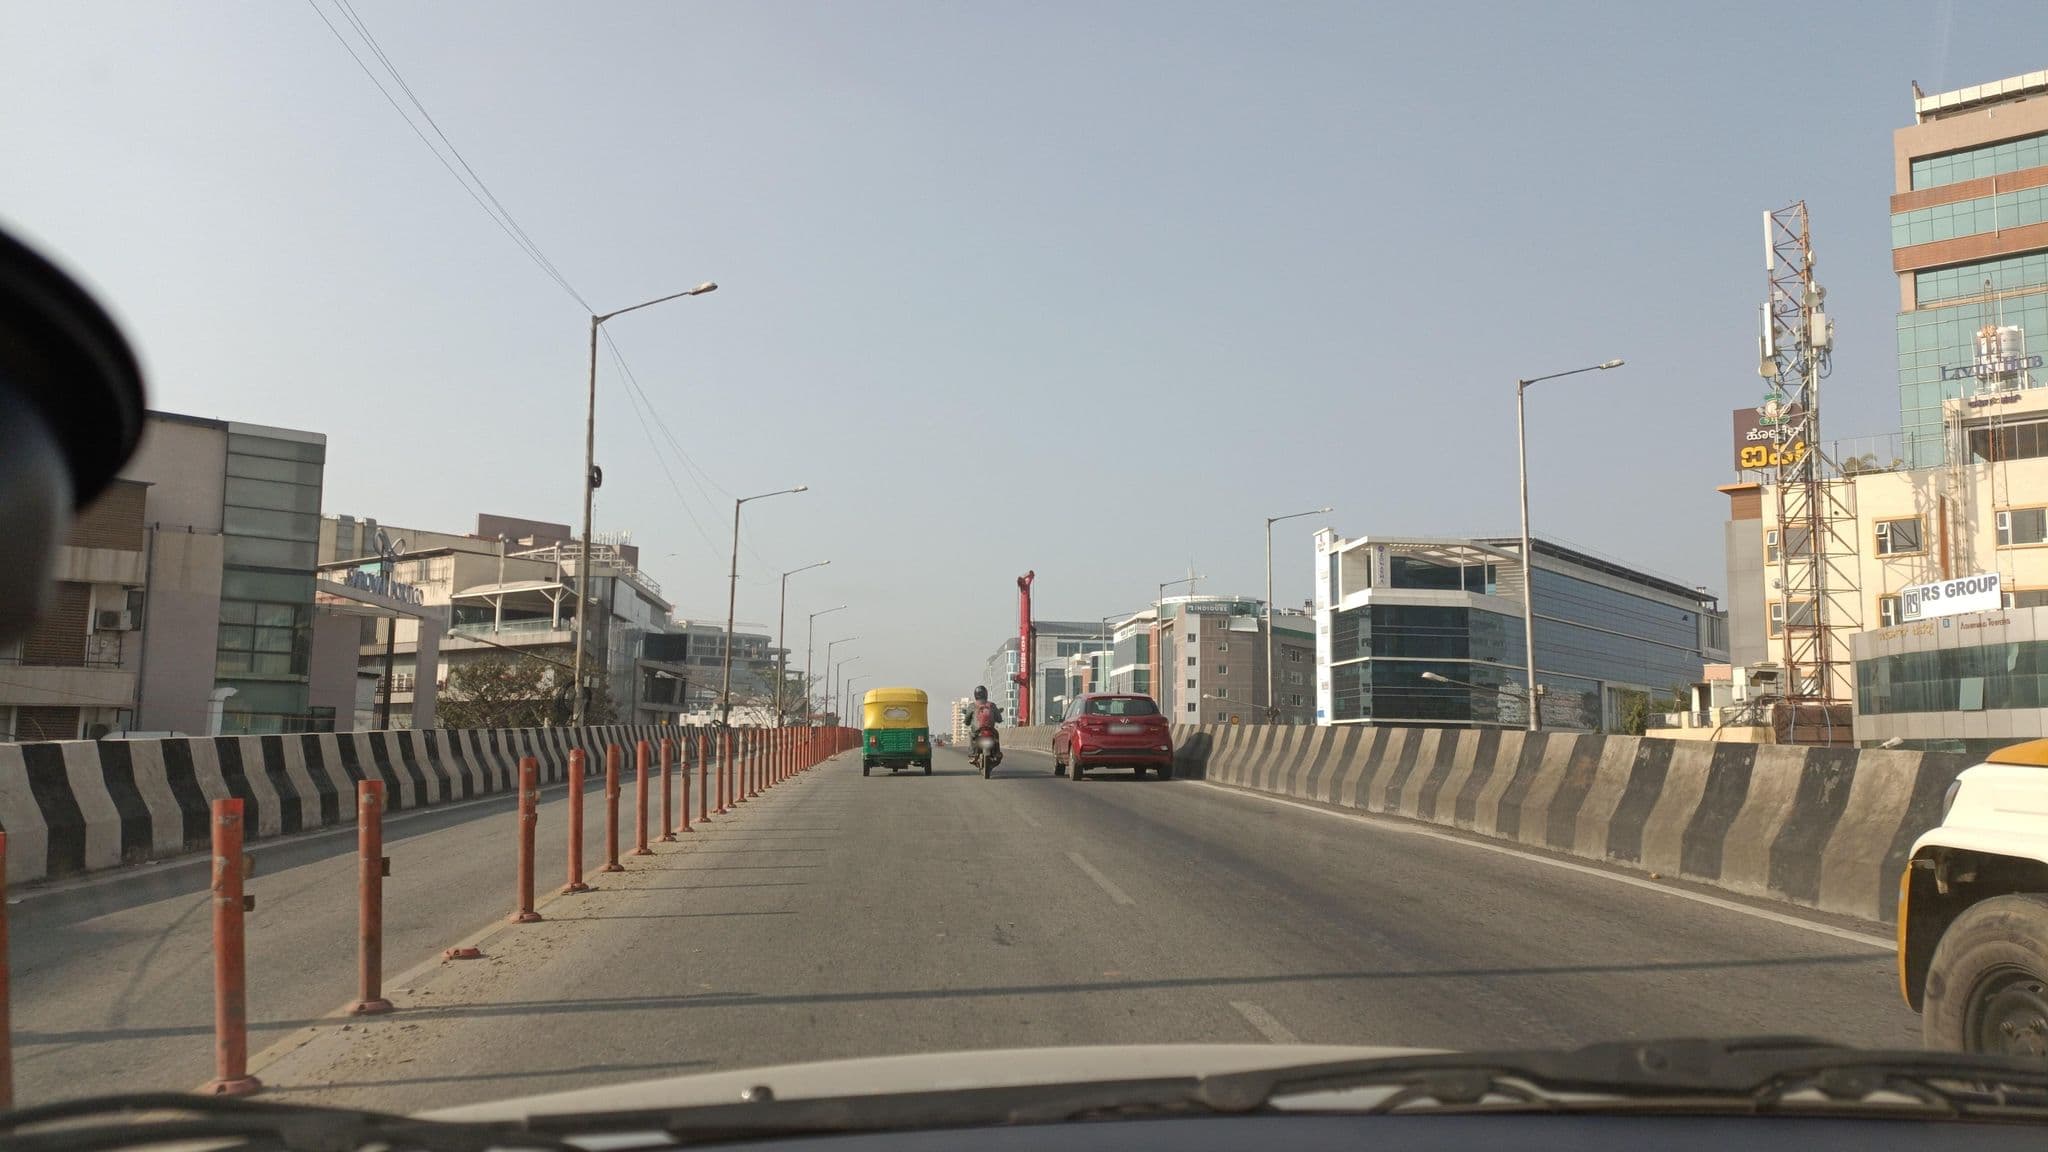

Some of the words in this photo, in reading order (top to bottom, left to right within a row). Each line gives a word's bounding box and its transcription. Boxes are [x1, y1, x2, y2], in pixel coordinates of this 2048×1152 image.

[1921, 585, 1941, 602] RS
[1945, 575, 1998, 598] GROUP
[1906, 592, 1919, 615] RS
